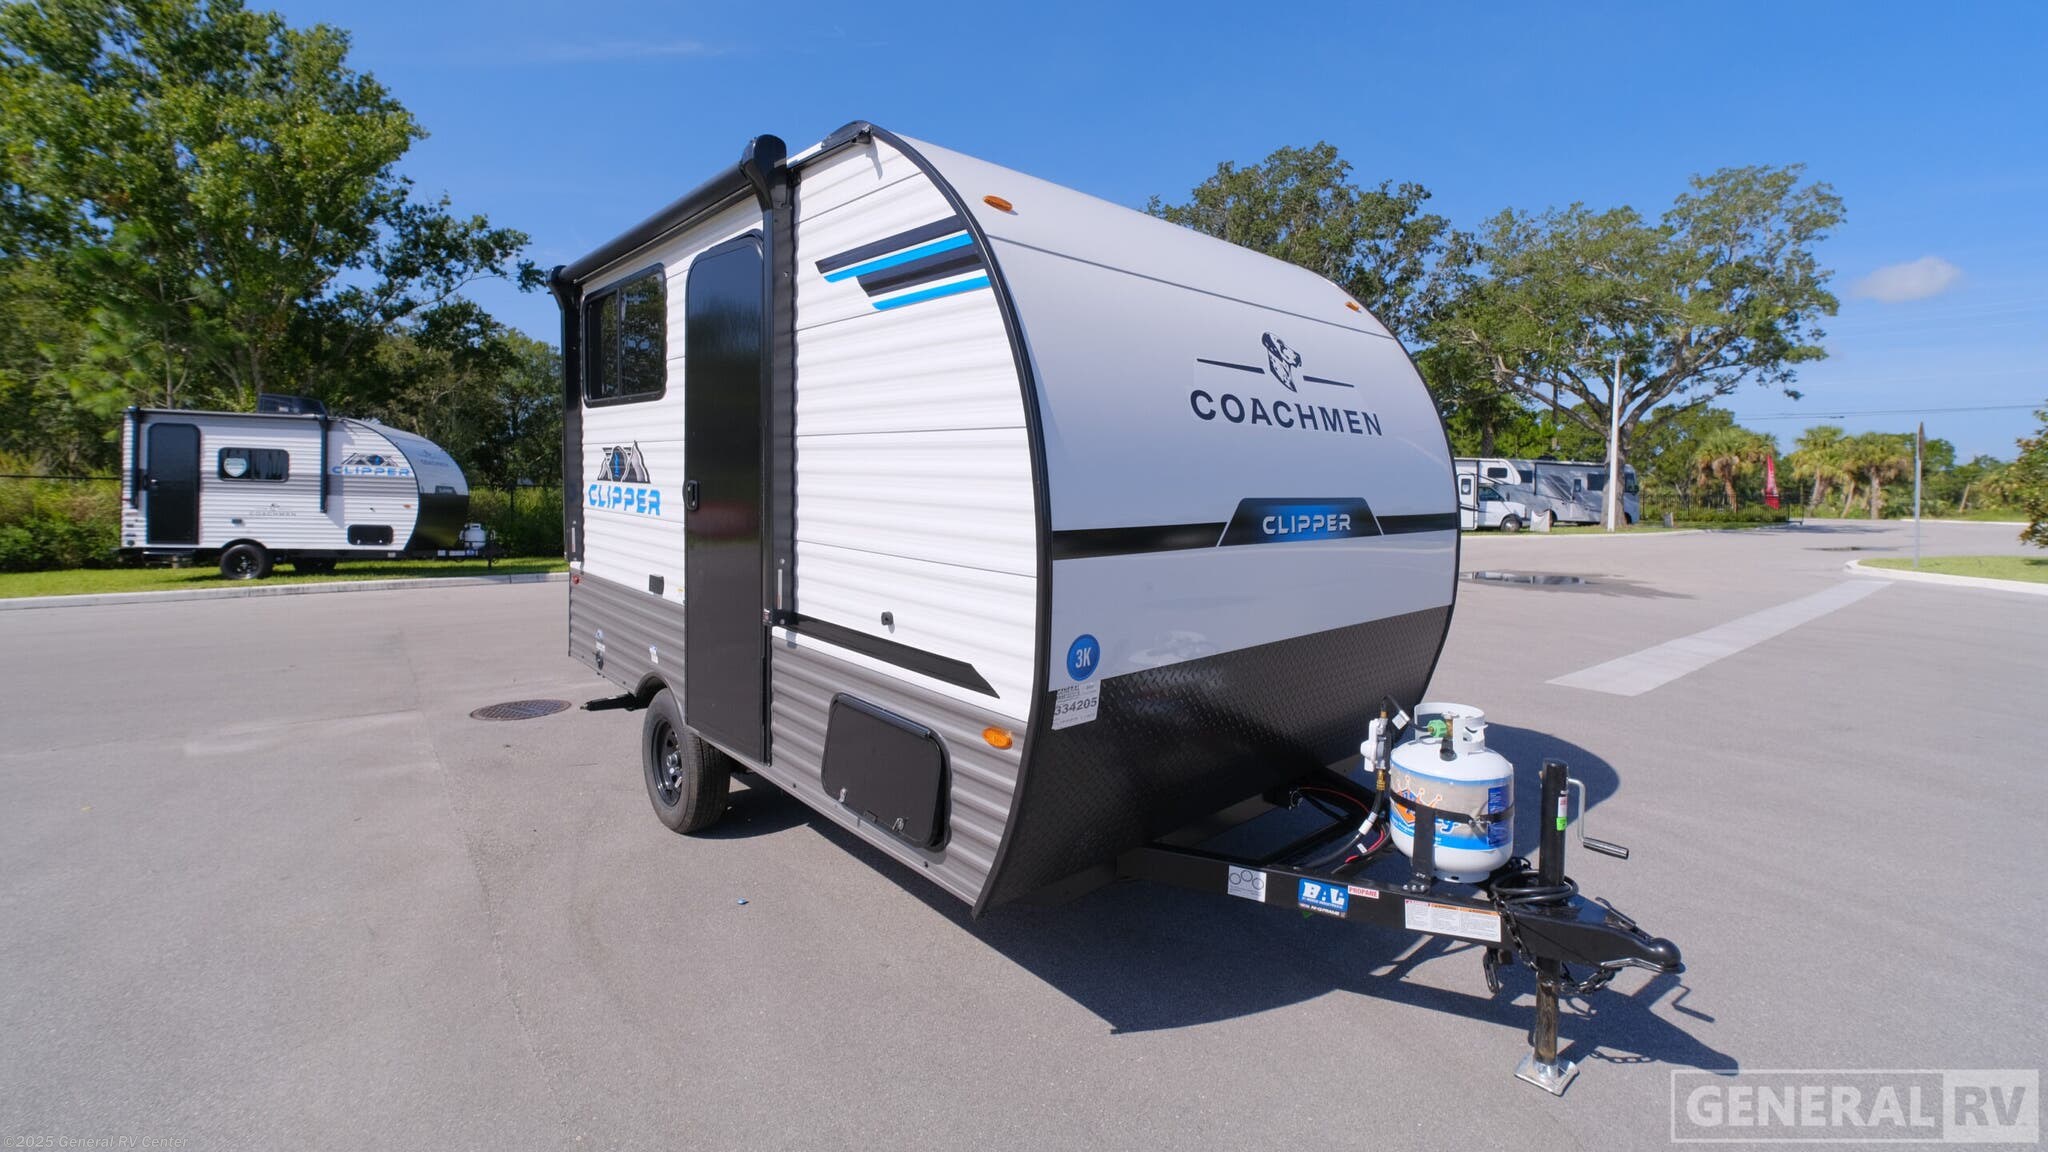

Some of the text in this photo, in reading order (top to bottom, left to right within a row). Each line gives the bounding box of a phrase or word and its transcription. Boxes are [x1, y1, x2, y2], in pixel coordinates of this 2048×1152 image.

[1190, 389, 1382, 436] COACHMEN
[331, 466, 410, 477] CLIPPER
[588, 484, 661, 516] CLIPPER
[1262, 513, 1351, 535] CLIPPER
[1075, 647, 1092, 668] 3K
[1054, 697, 1098, 716] 334205
[1349, 887, 1378, 897] PROPANE
